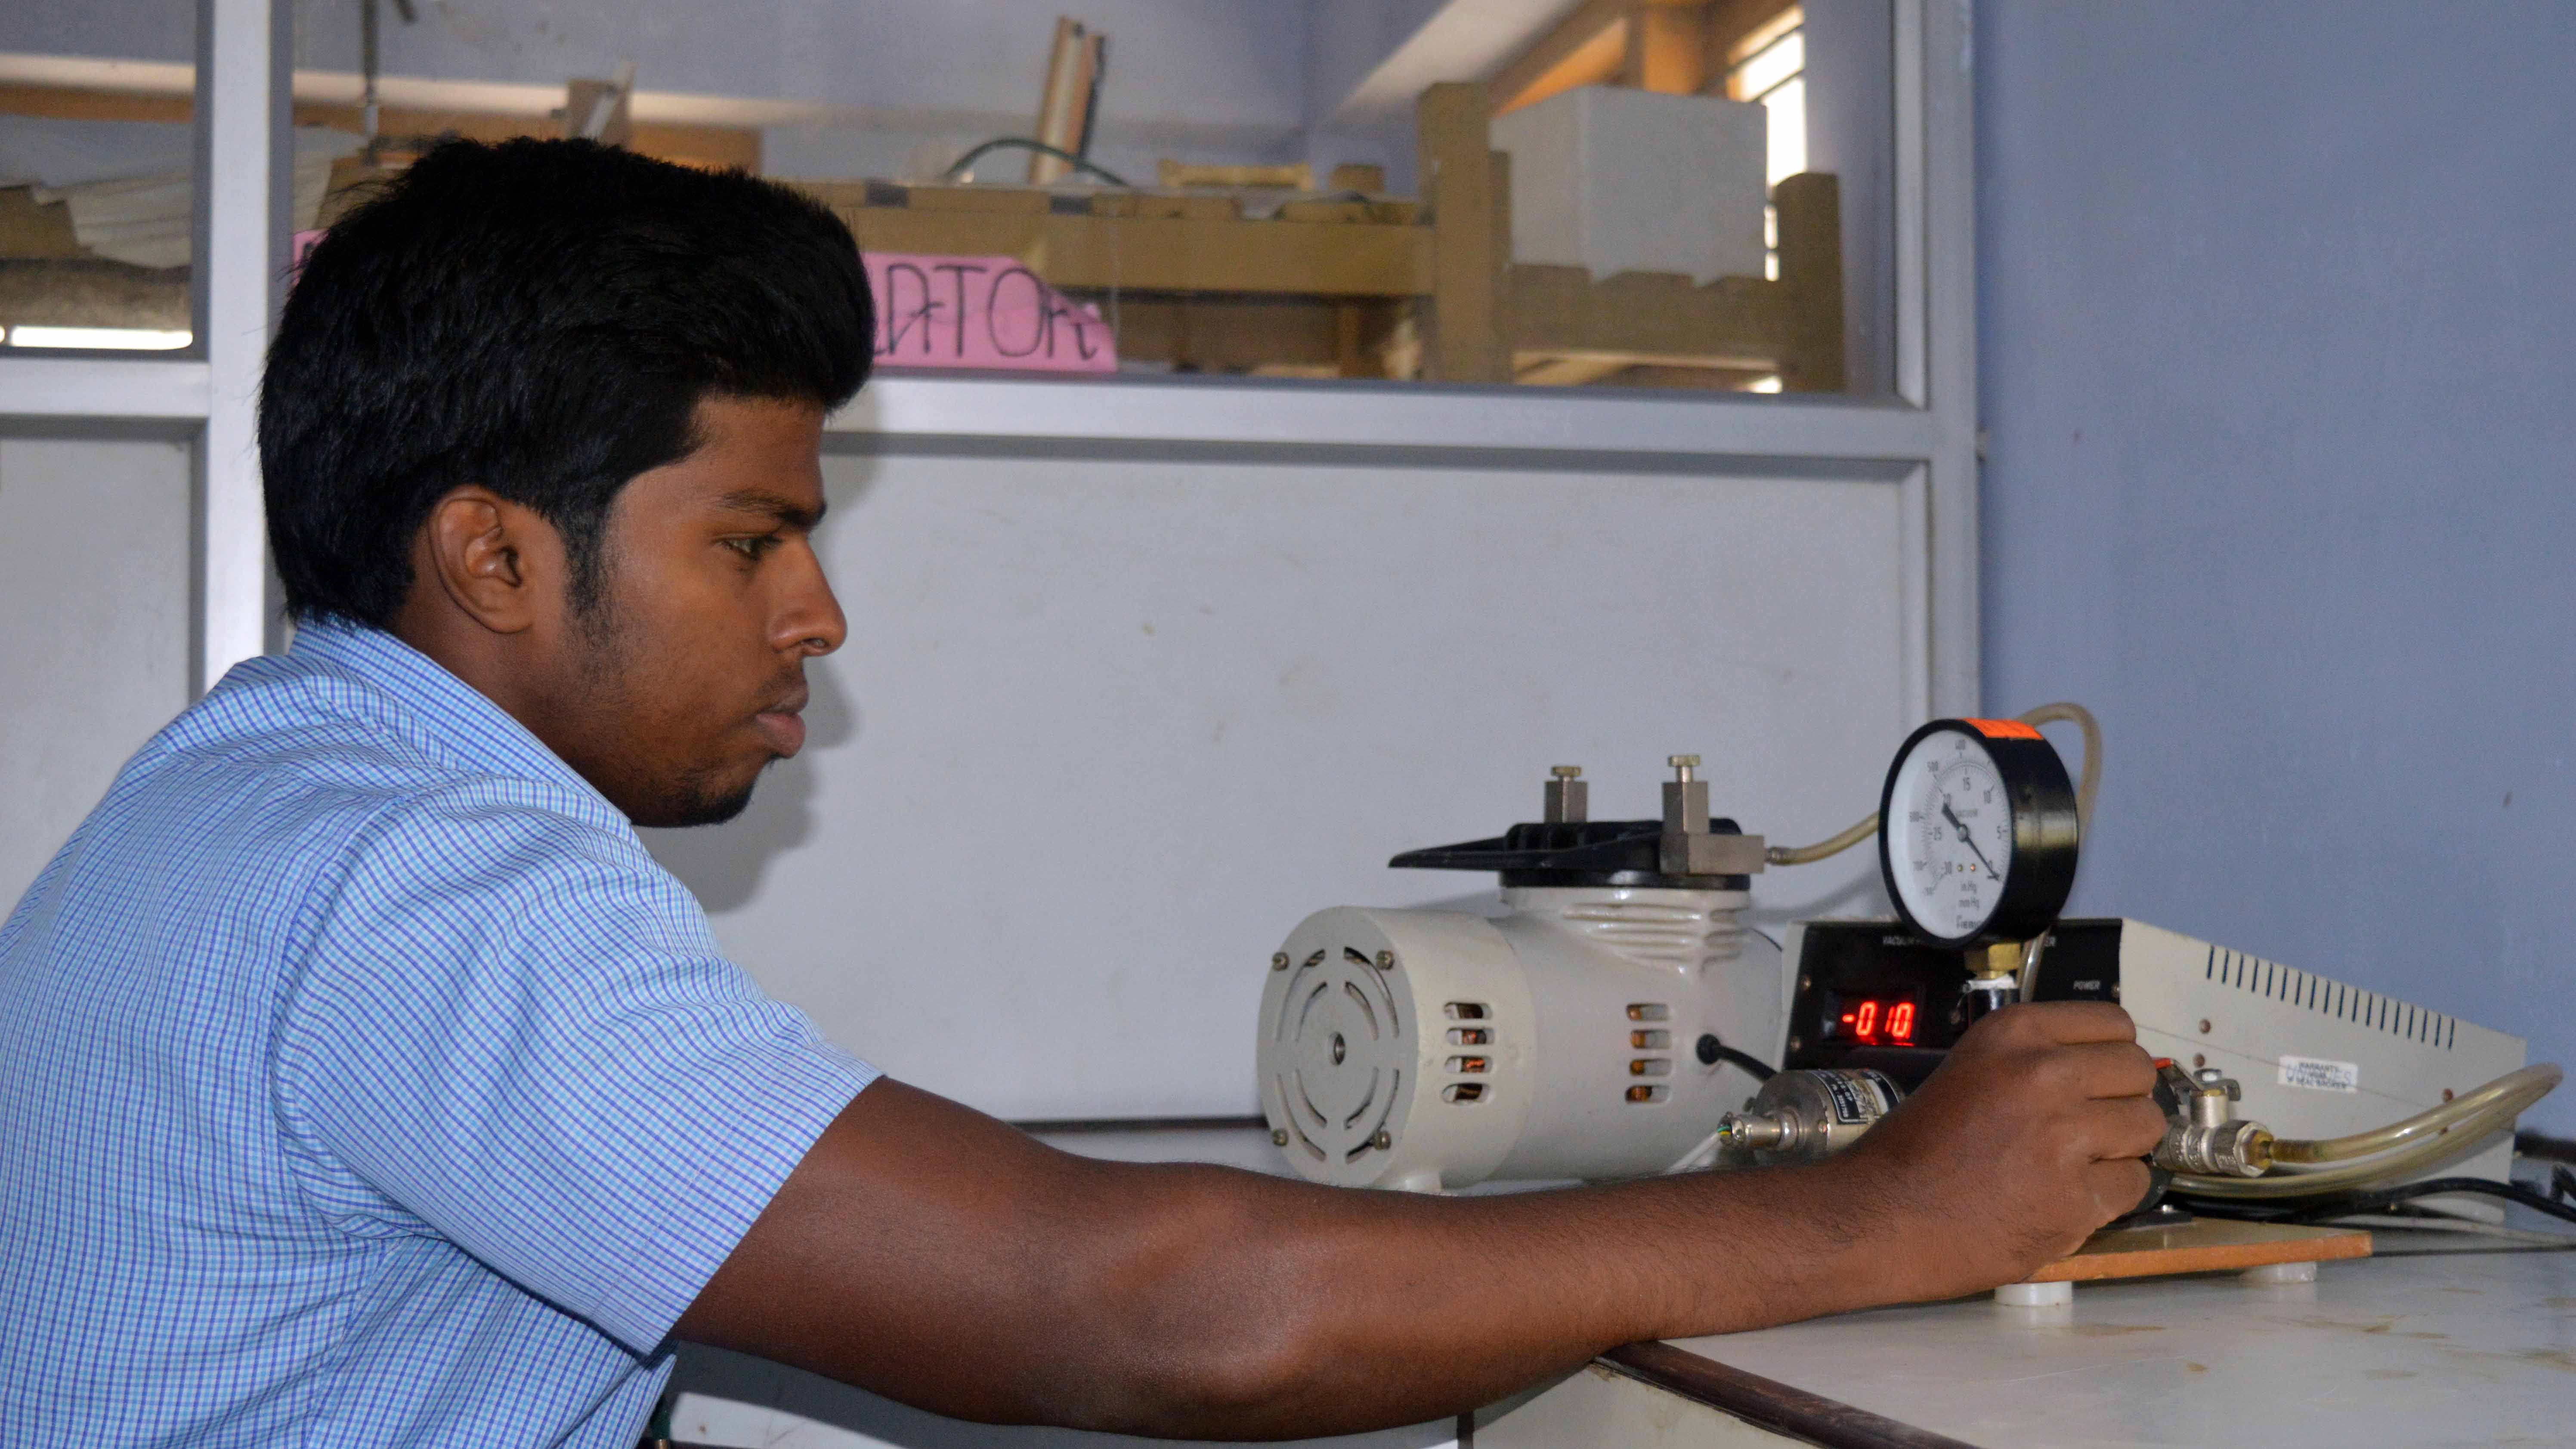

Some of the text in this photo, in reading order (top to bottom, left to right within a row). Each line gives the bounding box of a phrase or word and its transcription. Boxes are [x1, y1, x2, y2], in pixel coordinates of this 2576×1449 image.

[874, 263, 1098, 360] ATOR
[1963, 777, 1970, 791] 15
[1996, 825, 2002, 839] 5
[2073, 980, 2101, 991] POWER
